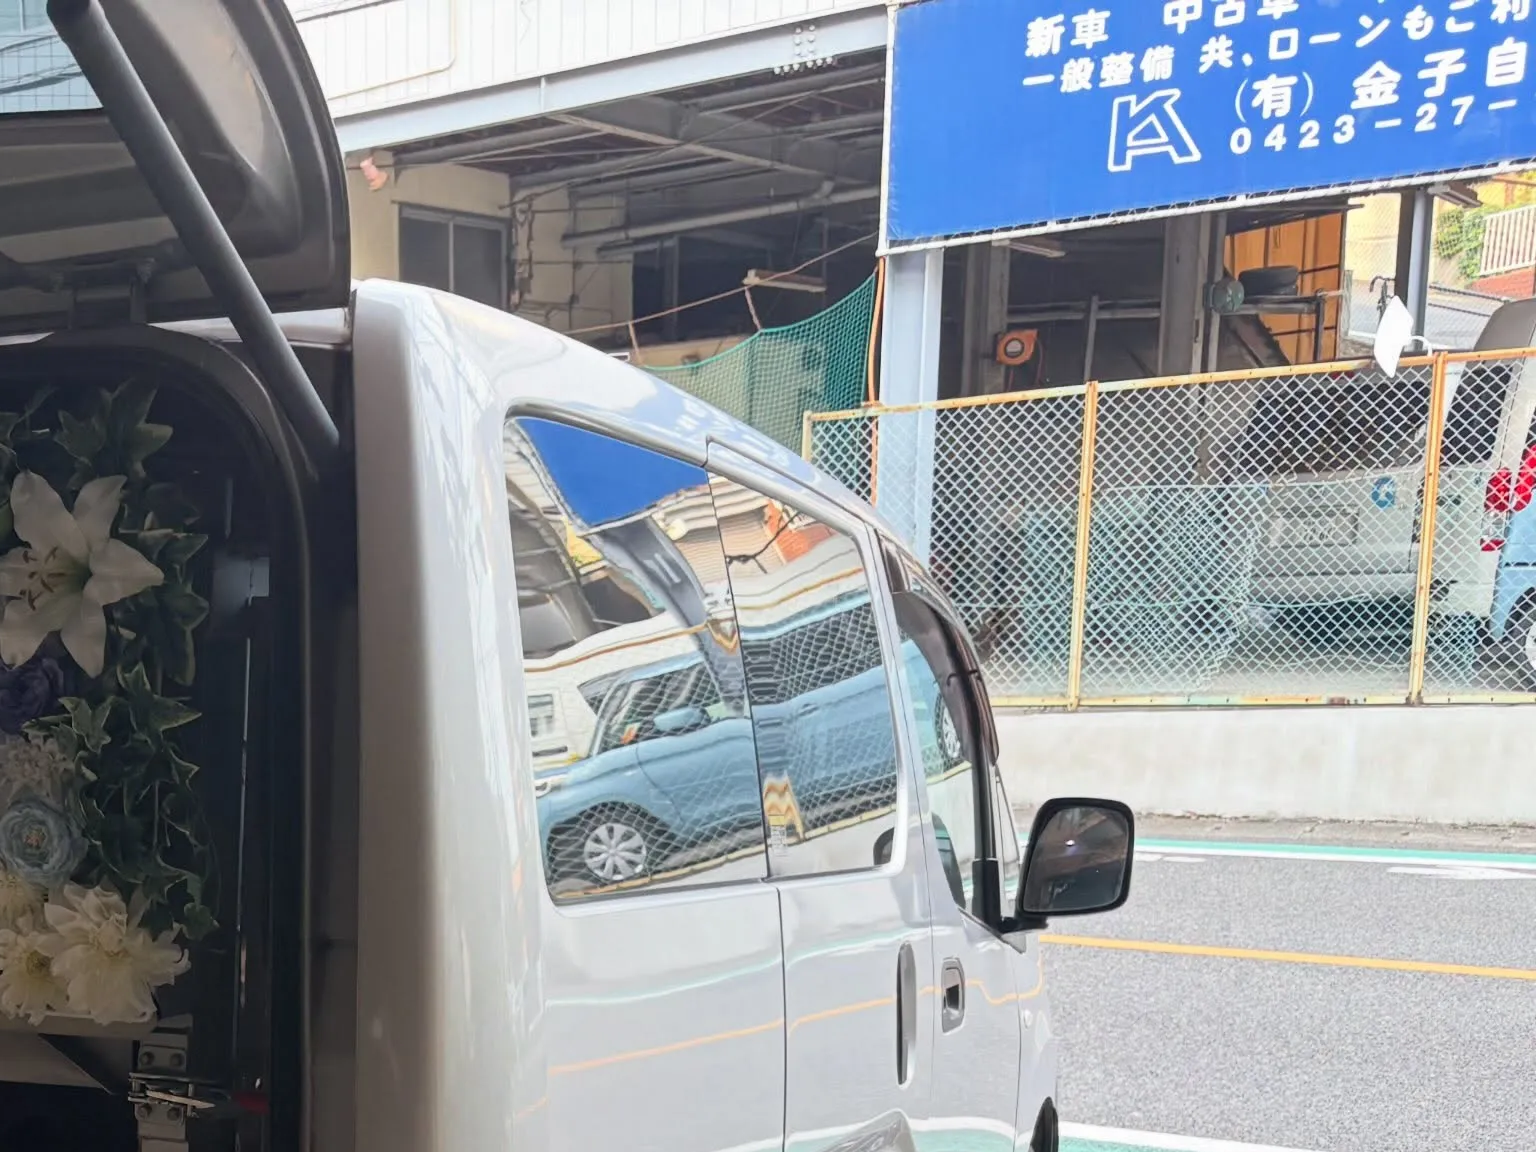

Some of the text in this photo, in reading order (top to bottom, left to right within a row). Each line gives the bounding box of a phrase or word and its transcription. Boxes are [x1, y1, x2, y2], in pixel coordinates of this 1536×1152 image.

[1025, 8, 1111, 57] 新車
[1022, 45, 1175, 93] 一般整備
